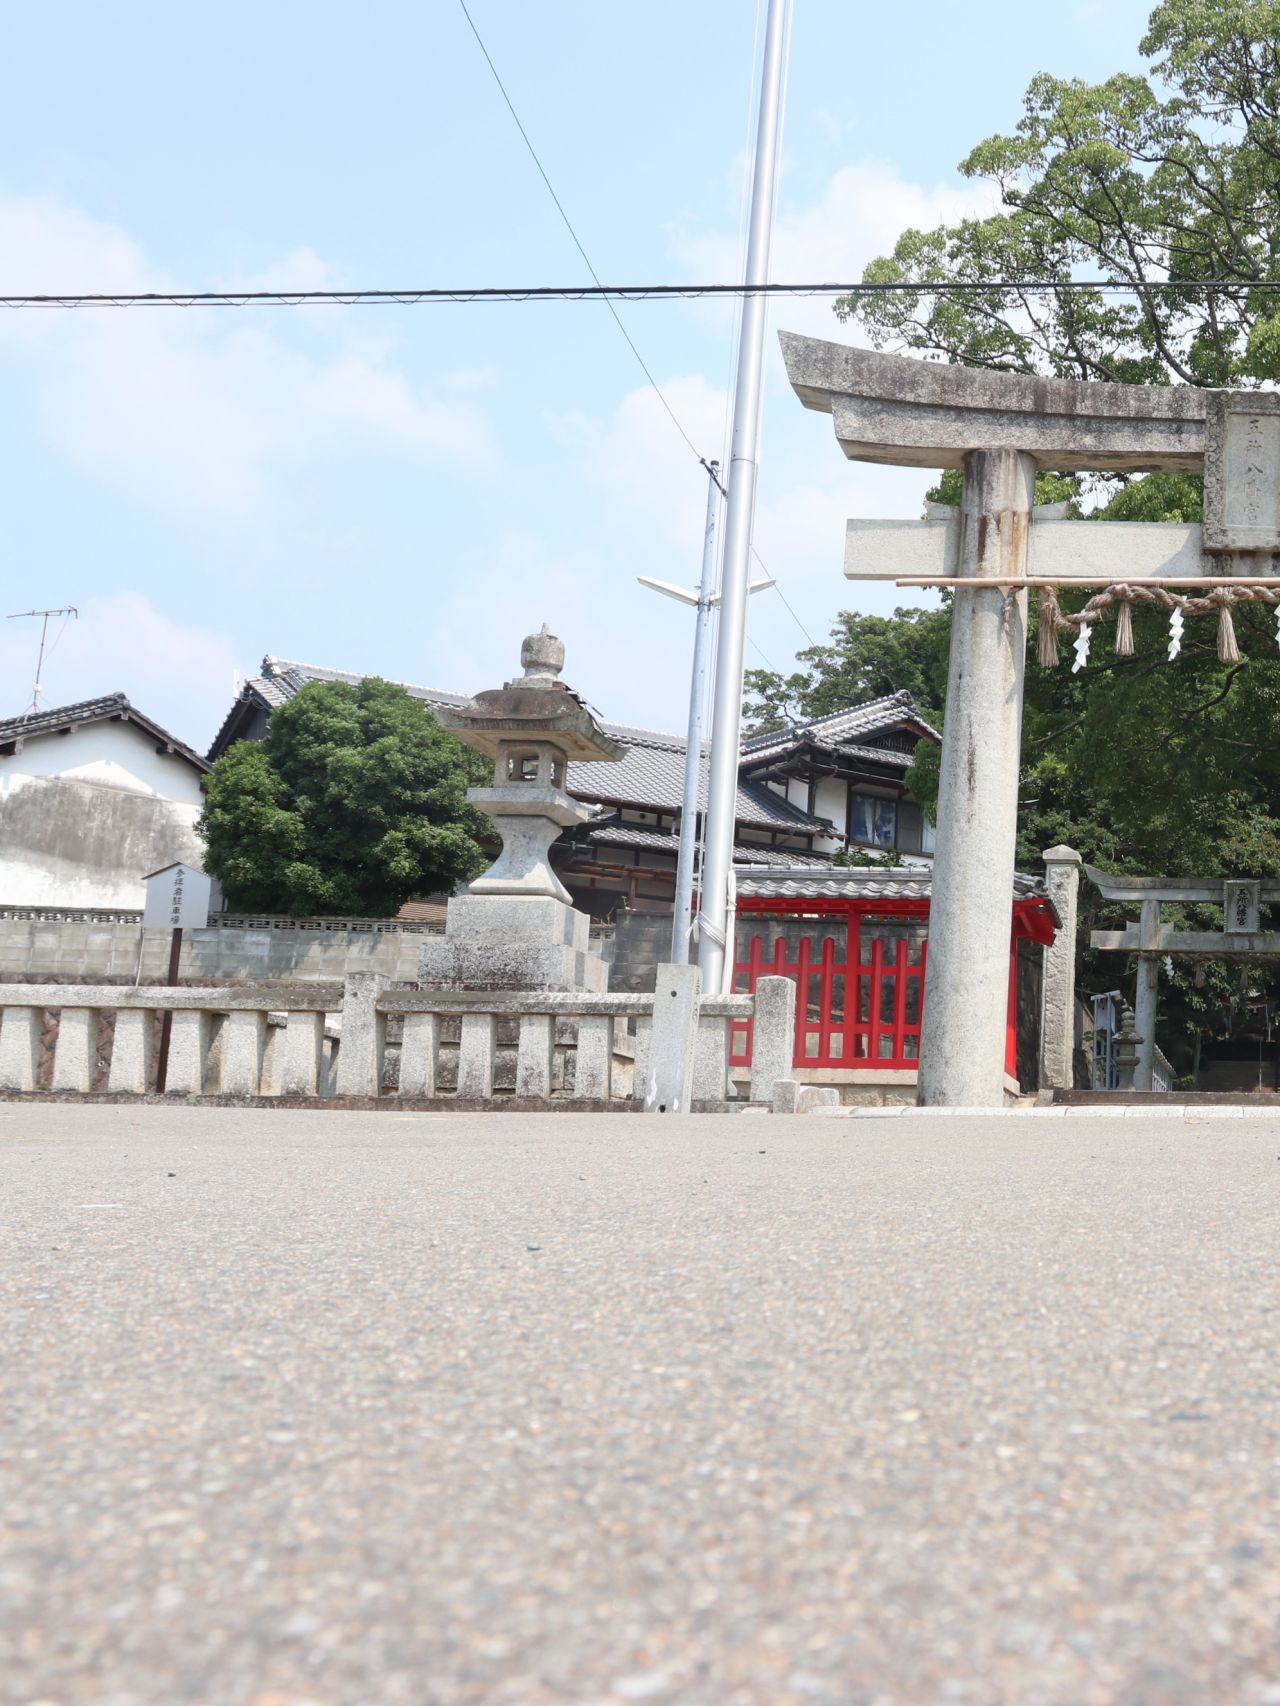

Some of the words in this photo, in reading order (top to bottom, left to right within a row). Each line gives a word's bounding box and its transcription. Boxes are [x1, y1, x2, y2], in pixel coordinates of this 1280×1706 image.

[170, 868, 184, 925] 参拝者駐車場
